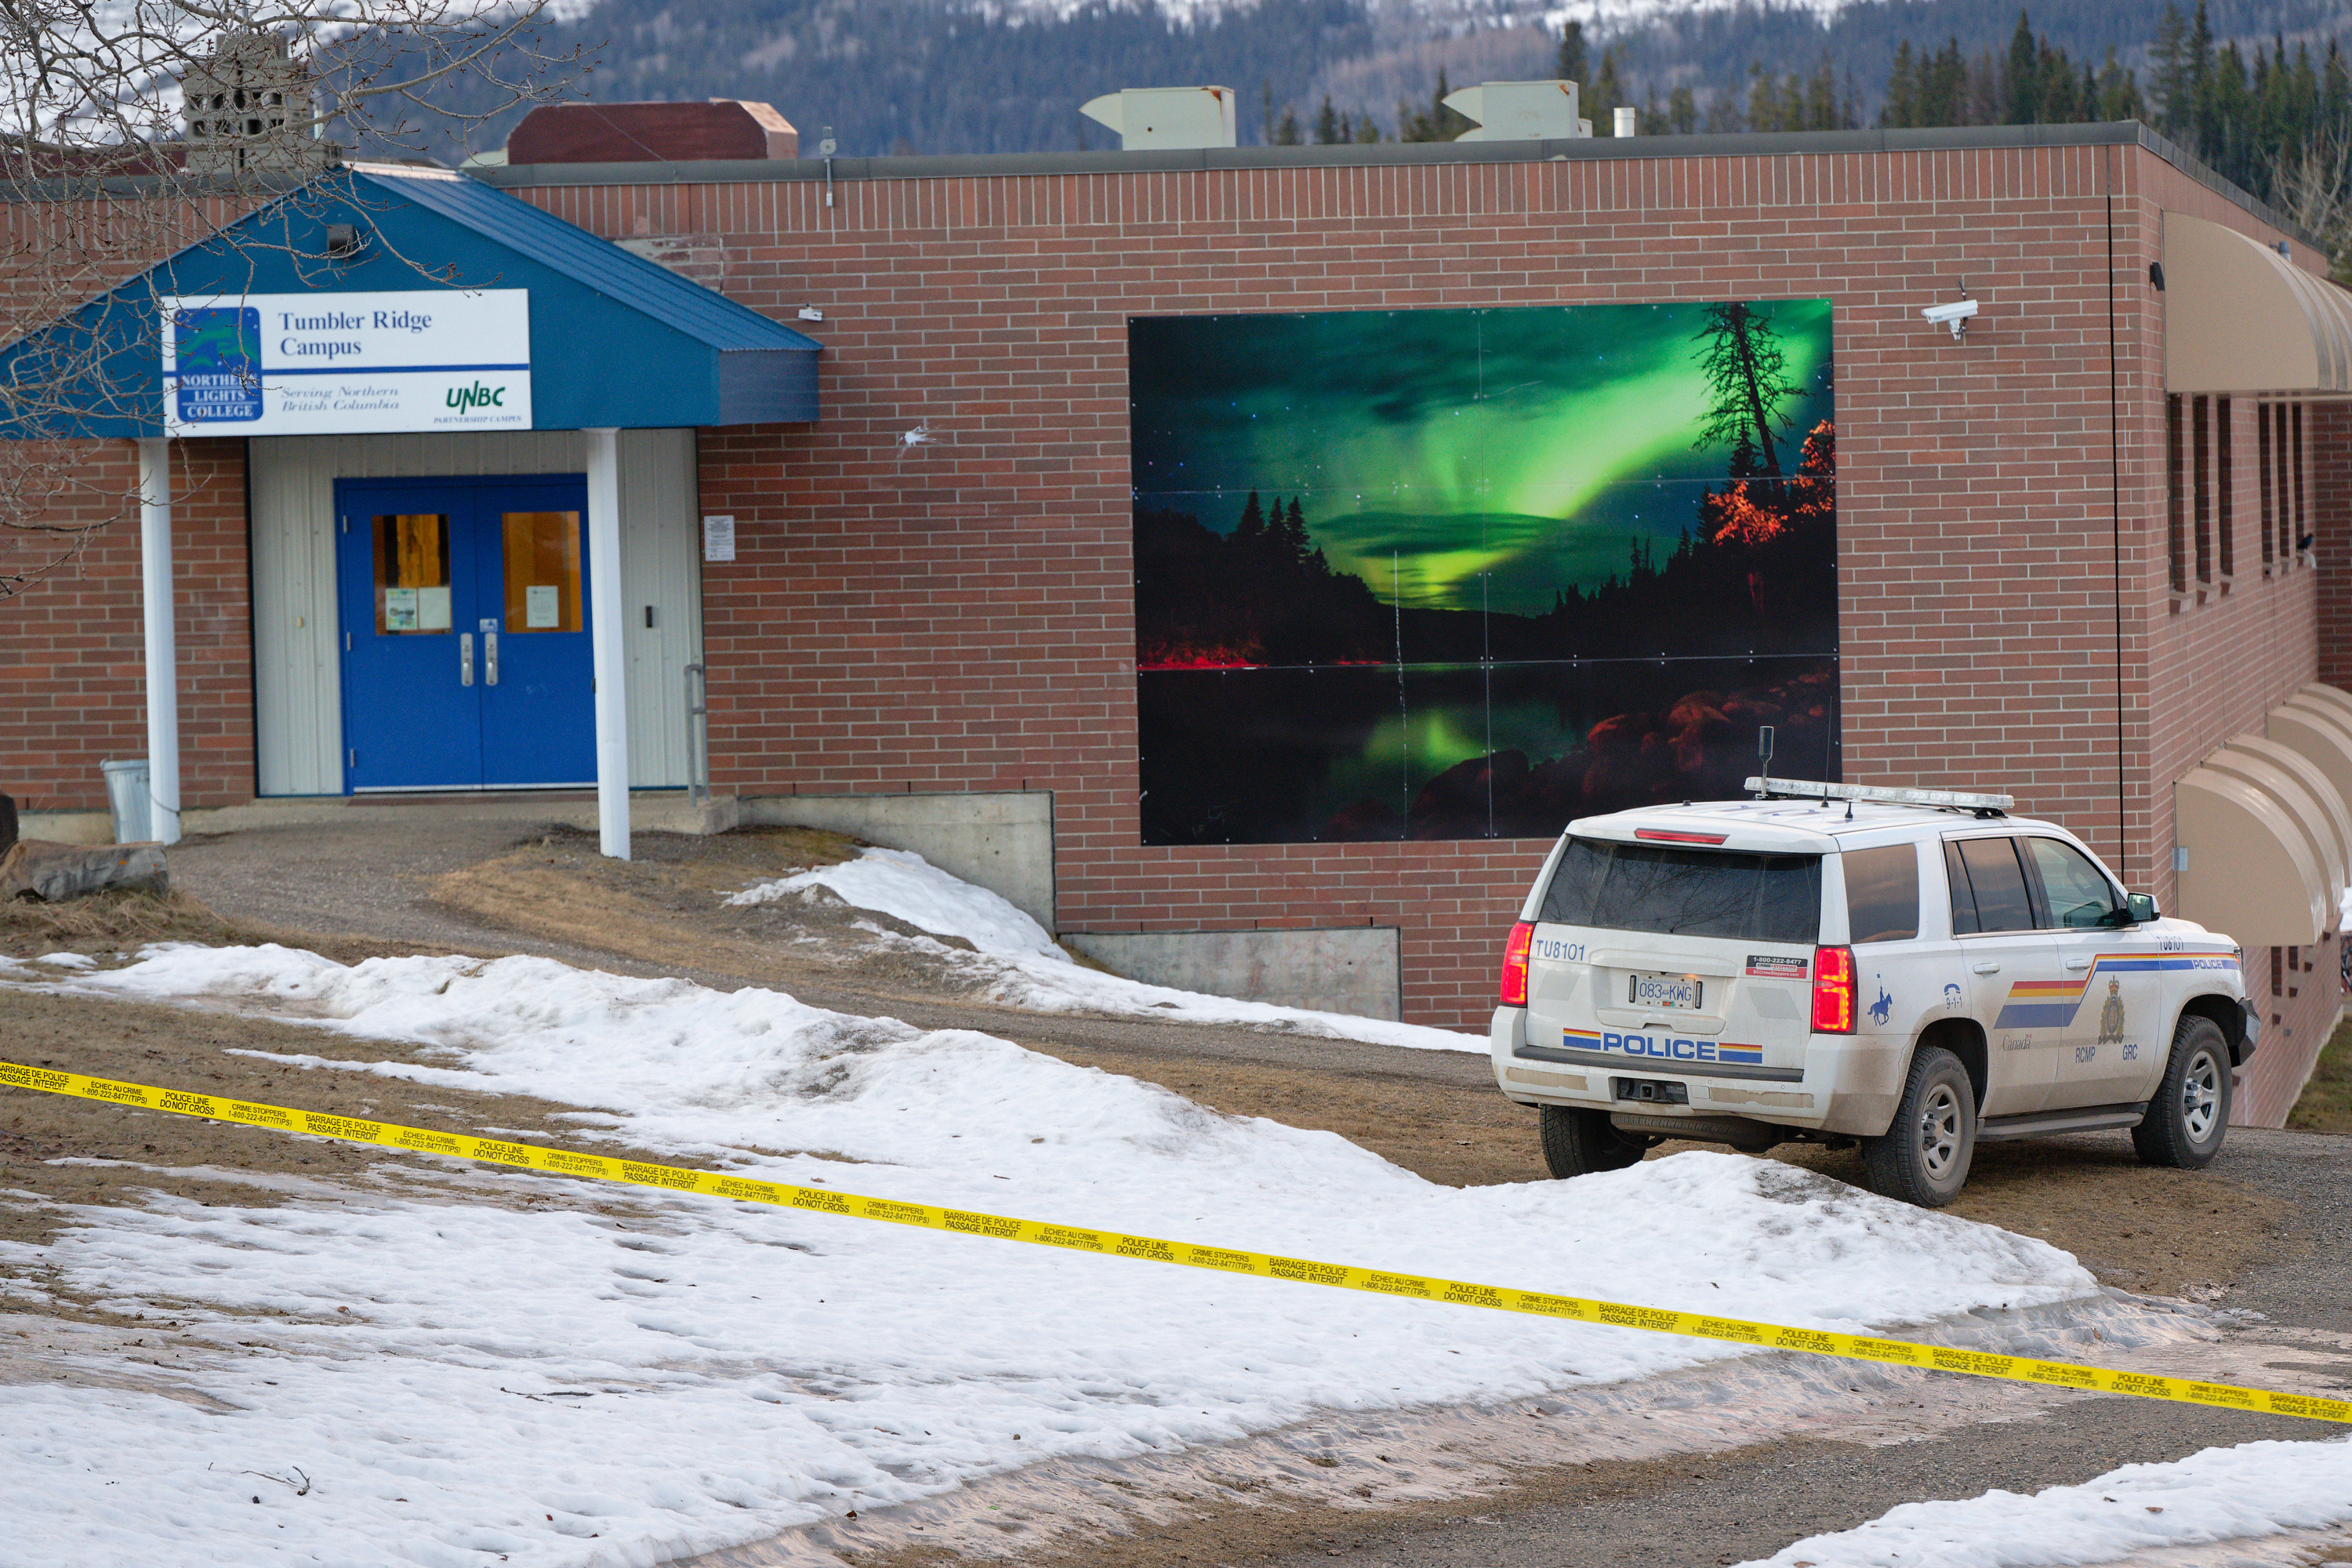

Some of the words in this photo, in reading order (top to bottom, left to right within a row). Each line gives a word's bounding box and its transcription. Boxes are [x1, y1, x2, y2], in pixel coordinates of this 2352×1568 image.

[278, 311, 365, 330] Tumbler
[373, 310, 432, 334] Ridge
[280, 337, 361, 360] Campus
[194, 390, 246, 402] LIGHTS
[281, 386, 332, 399] Serving
[338, 386, 399, 397] Northern
[445, 380, 506, 415] UNBC
[187, 405, 254, 418] COLLEGE
[281, 400, 328, 412] British
[333, 398, 400, 412] Columbia
[434, 416, 488, 424] PARTNERSHIP
[489, 415, 522, 423] CAMPUS
[1537, 939, 1585, 961] TU8101
[2193, 960, 2223, 970] POLICE
[1639, 982, 1662, 999] 083
[1669, 985, 1692, 1001] KWG
[1946, 996, 1962, 1010] 9-1-1
[1603, 1032, 1716, 1061] POLICE
[2002, 1034, 2031, 1051] Canada
[2075, 1046, 2096, 1064] RCMP
[2122, 1044, 2138, 1061] GRC
[0, 1065, 31, 1079] ARRAGE
[31, 1070, 43, 1080] DE
[42, 1072, 69, 1084] POLICE
[33, 1078, 66, 1091] INTERDIT
[90, 1080, 112, 1091] ÉCHEC
[122, 1086, 143, 1096] CRIME
[165, 1091, 191, 1103] POLICE
[193, 1096, 209, 1106] LINE
[159, 1098, 172, 1108] DO
[172, 1101, 188, 1111] NOT
[188, 1103, 215, 1116] CROSS
[231, 1103, 252, 1112] CRIME
[252, 1106, 286, 1119] STOPPERS
[305, 1113, 341, 1127] BARRAGE
[343, 1120, 353, 1128] DE
[354, 1121, 381, 1133] POLICE
[307, 1122, 342, 1135] PASSAGE
[343, 1128, 377, 1141] INTERDIT
[403, 1130, 425, 1141] ÉCHEC
[435, 1135, 456, 1145] CRIME
[473, 1148, 485, 1157] DO
[485, 1150, 503, 1160] NOT
[503, 1152, 529, 1164] CROSS
[479, 1141, 506, 1152] POLICE
[507, 1145, 524, 1155] LINE
[546, 1152, 568, 1162] CRIME
[568, 1155, 603, 1167] STOPPERS
[622, 1163, 659, 1175] BARRAGE
[659, 1168, 670, 1178] DE
[672, 1171, 699, 1181] POLICE
[623, 1171, 659, 1185] PASSAGE
[661, 1177, 695, 1189] INTERDIT
[721, 1179, 743, 1189] ÉCHEC
[754, 1184, 775, 1194] CRIME
[798, 1189, 826, 1201] POLICE
[827, 1194, 844, 1203] LINE
[792, 1196, 804, 1206] DO
[804, 1199, 822, 1208] NOT
[822, 1201, 850, 1213] CROSS
[867, 1200, 888, 1210] CRIME
[888, 1203, 924, 1215] STOPPERS
[943, 1211, 980, 1224] BARRAGE
[982, 1217, 992, 1225] DE
[993, 1218, 1022, 1230] POLICE
[945, 1219, 981, 1232] PASSAGE
[982, 1225, 1017, 1238] INTERDIT
[1044, 1226, 1066, 1237] ÉCHEC
[1077, 1232, 1098, 1242] CRIME
[1122, 1237, 1150, 1249] POLICE
[1151, 1242, 1168, 1251] LINE
[1116, 1244, 1128, 1254] DO
[1128, 1247, 1146, 1257] NOT
[1146, 1249, 1174, 1261] CROSS
[1192, 1248, 1213, 1258] CRIME
[1214, 1250, 1249, 1263] STOPPERS
[1269, 1258, 1306, 1271] BARRAGE
[1307, 1264, 1318, 1272] DE
[1319, 1265, 1348, 1277] POLICE
[1270, 1267, 1307, 1279] PASSAGE
[1308, 1272, 1344, 1285] INTERDIT
[1370, 1273, 1394, 1283] ÉCHEC
[1404, 1279, 1425, 1288] CRIME
[1443, 1291, 1456, 1301] DO
[1456, 1293, 1474, 1303] NOT
[1474, 1295, 1502, 1307] CROSS
[1450, 1284, 1478, 1295] POLICE
[1479, 1288, 1497, 1298] LINE
[1520, 1294, 1541, 1304] CRIME
[1542, 1297, 1578, 1309] STOPPERS
[1599, 1305, 1636, 1316] BARRAGE
[1650, 1312, 1679, 1323] POLICE
[1599, 1312, 1637, 1326] PASSAGE
[1639, 1318, 1675, 1330] INTERDIT
[1701, 1319, 1725, 1329] ÉCHEC
[1736, 1324, 1758, 1334] CRIME
[1782, 1329, 1810, 1340] POLICE
[1812, 1334, 1829, 1342] LINE
[1776, 1336, 1788, 1346] DO
[1788, 1338, 1806, 1348] NOT
[1806, 1341, 1835, 1352] CROSS
[1853, 1339, 1875, 1348] CRIME
[1875, 1342, 1912, 1355] STOPPERS
[1933, 1349, 1970, 1362] BARRAGE
[1972, 1355, 1983, 1363] DE
[1984, 1356, 2013, 1367] POLICE
[1934, 1358, 1971, 1370] PASSAGE
[1973, 1363, 2009, 1374] INTERDIT
[2036, 1363, 2060, 1374] ÉCHEC
[2071, 1369, 2092, 1378] CRIME
[2118, 1374, 2146, 1385] POLICE
[2147, 1378, 2165, 1387] LINE
[2111, 1381, 2124, 1391] DO
[2125, 1383, 2142, 1392] NOT
[2143, 1385, 2171, 1397] CROSS
[2189, 1384, 2211, 1393] CRIME
[2212, 1388, 2249, 1399] STOPPERS
[2269, 1394, 2308, 1406] BARRAGE
[2308, 1399, 2320, 1407] DE
[2321, 1401, 2350, 1411] POLICE
[2270, 1403, 2308, 1414] PASSAGE
[2310, 1407, 2347, 1419] INTERDIT
